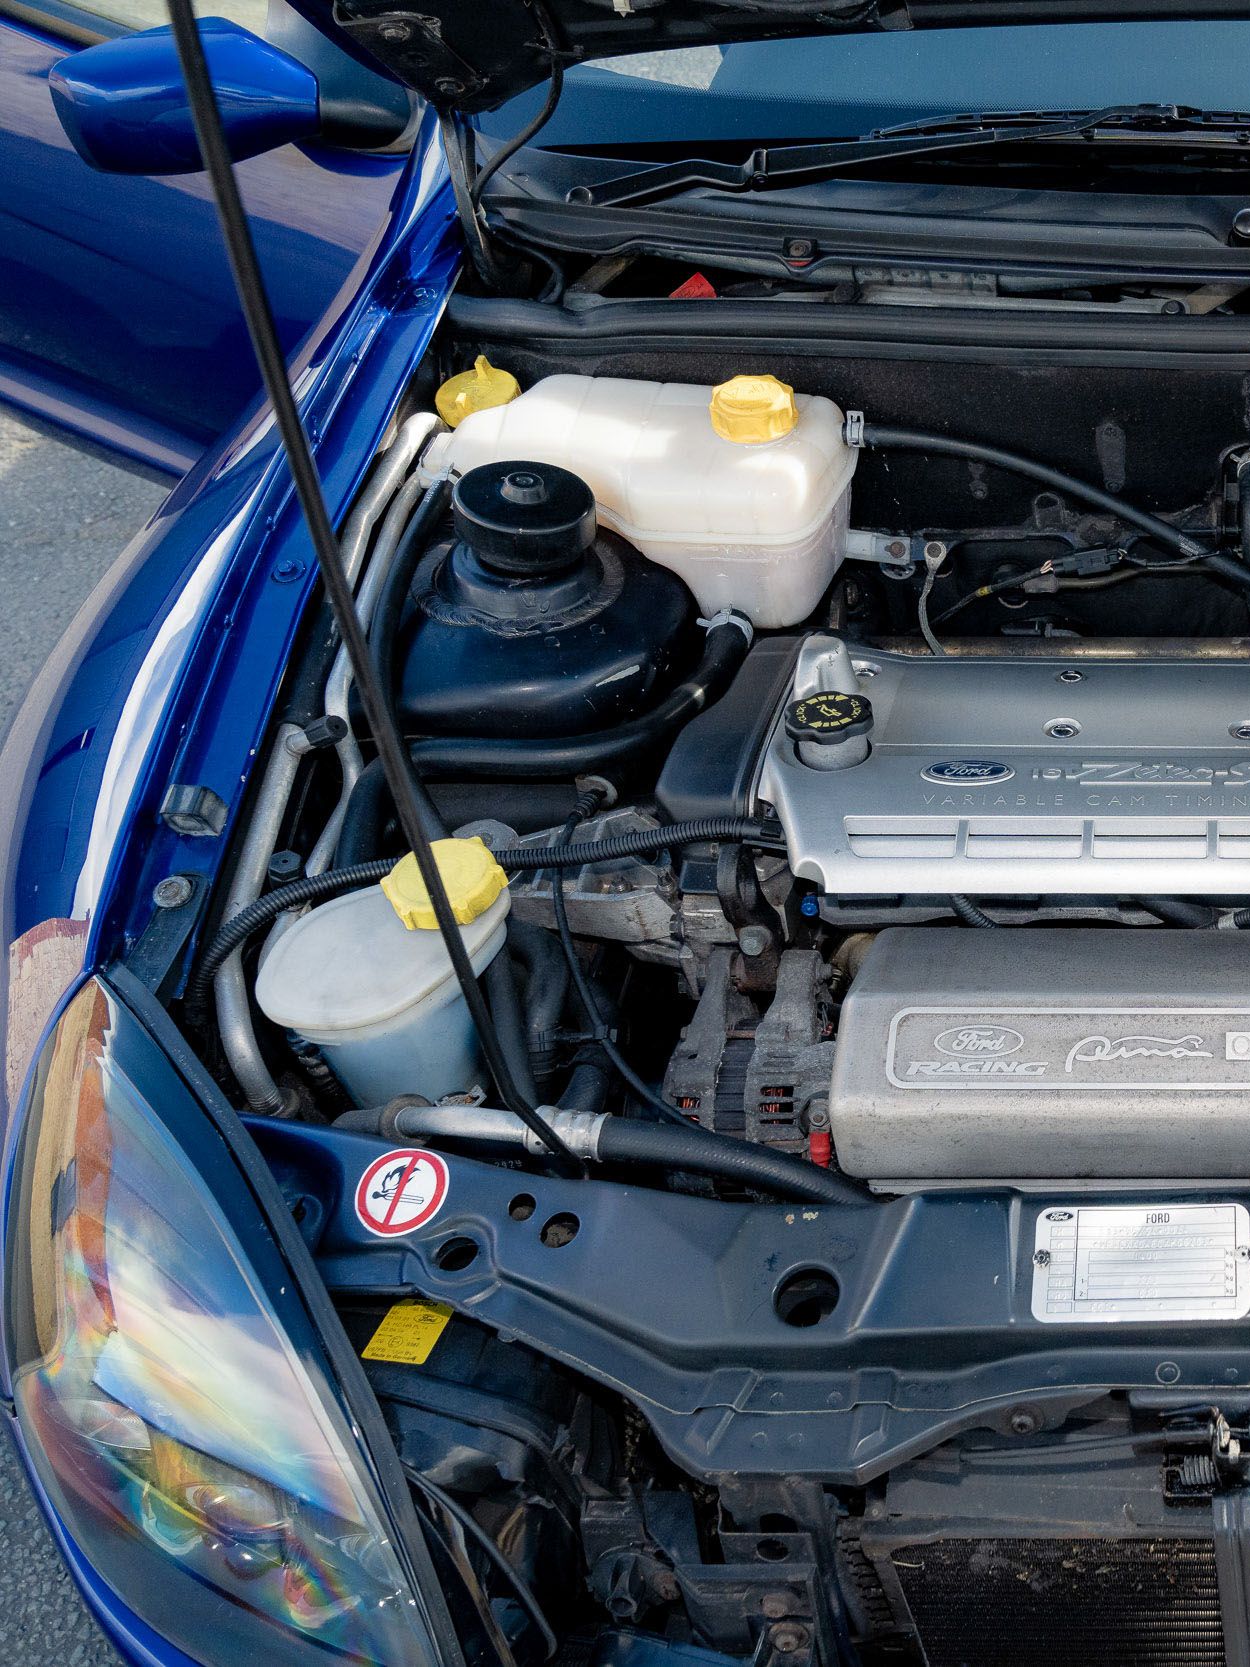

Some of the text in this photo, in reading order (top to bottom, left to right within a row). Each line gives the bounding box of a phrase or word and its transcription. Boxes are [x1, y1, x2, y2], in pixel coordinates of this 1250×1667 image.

[943, 763, 992, 778] Ford
[922, 794, 1064, 807] VARIABLE
[1086, 794, 1145, 807] CAM
[951, 1029, 1007, 1052] Ford
[904, 1060, 1050, 1077] RACING
[1145, 1213, 1170, 1224] FORD
